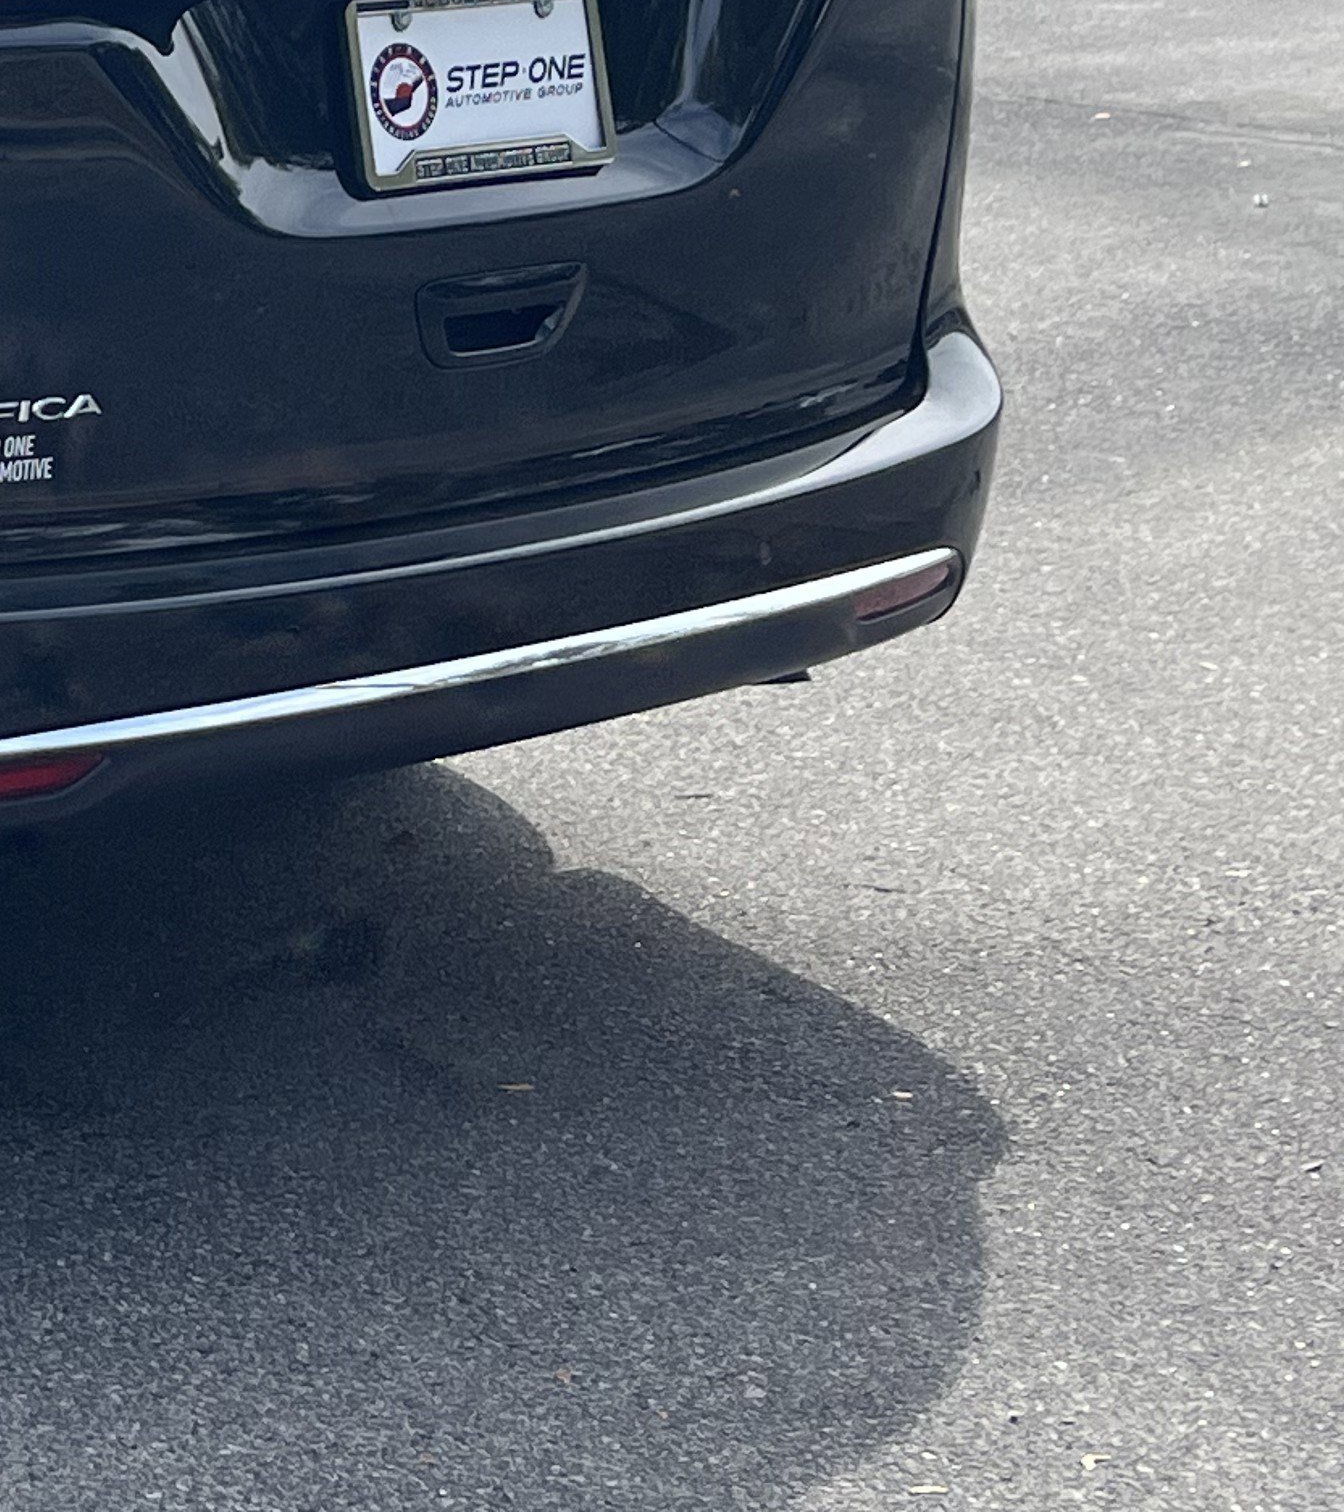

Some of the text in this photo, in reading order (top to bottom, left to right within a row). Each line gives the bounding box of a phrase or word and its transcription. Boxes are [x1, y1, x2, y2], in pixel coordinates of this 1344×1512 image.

[446, 53, 586, 93] STEP ONE
[445, 82, 584, 108] AUTOMOTIVE GROUP
[3, 434, 36, 458] ONE
